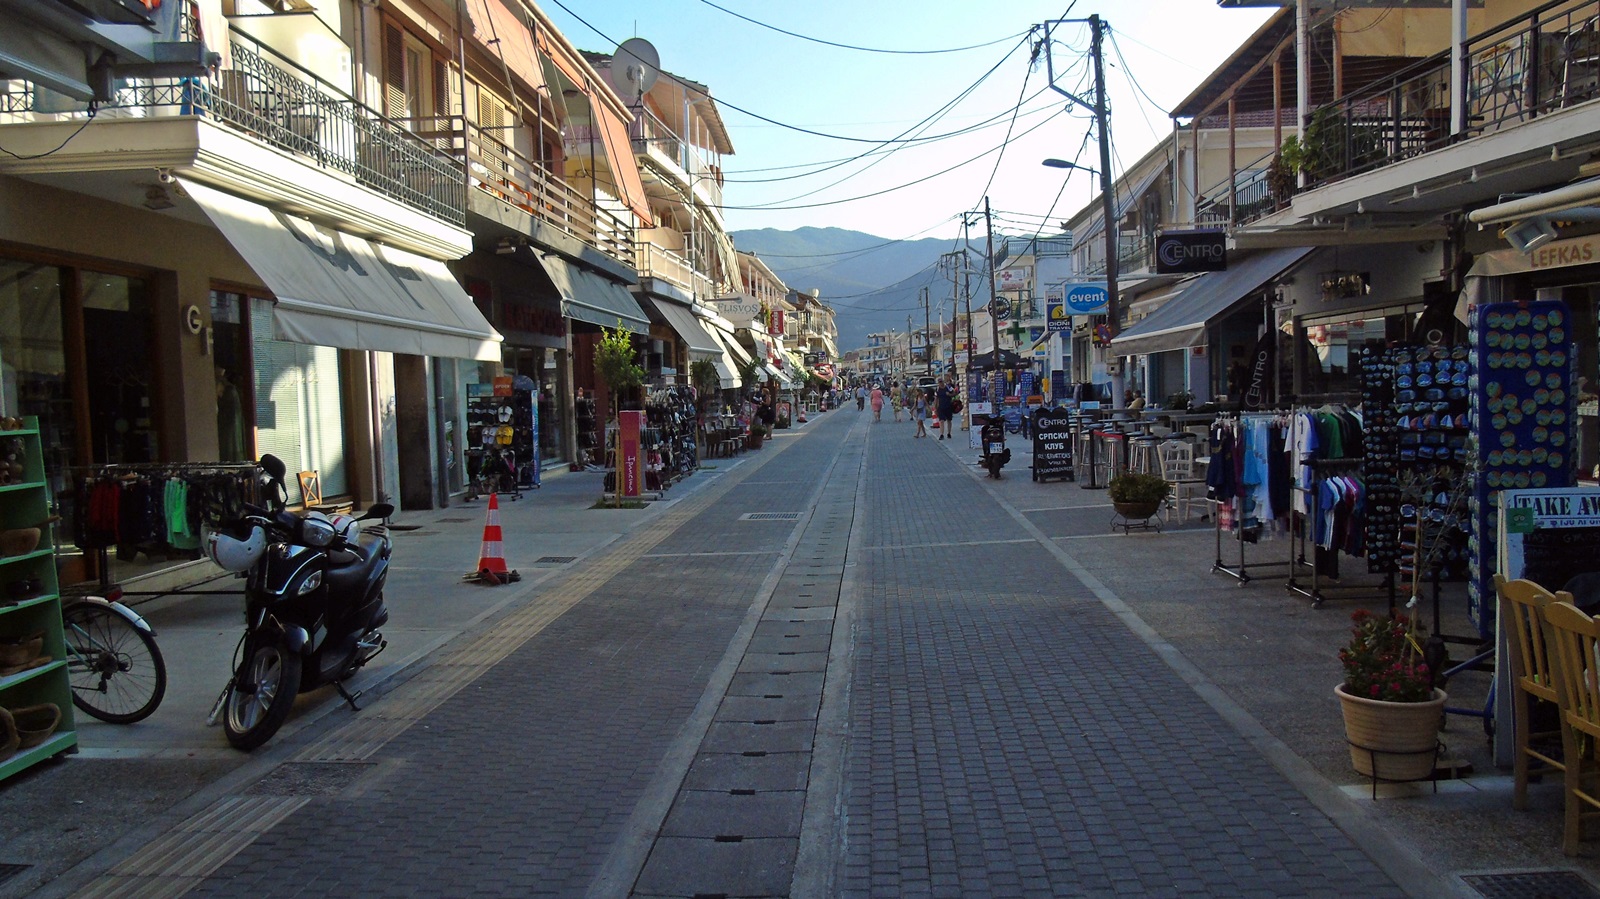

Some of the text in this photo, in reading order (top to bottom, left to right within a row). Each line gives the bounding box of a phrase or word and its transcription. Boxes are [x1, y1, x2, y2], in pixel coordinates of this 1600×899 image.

[1160, 240, 1223, 266] CENTRO
[1531, 243, 1593, 268] LEFKAS
[1070, 291, 1105, 303] event
[718, 303, 758, 313] FLISVOS
[772, 311, 780, 333] praxis
[1245, 351, 1267, 407] CENTRO
[1038, 417, 1067, 429] CENTRO
[1039, 432, 1068, 440] СРПСКИ
[626, 456, 636, 492] Ipanema
[1518, 497, 1571, 516] TAKE
